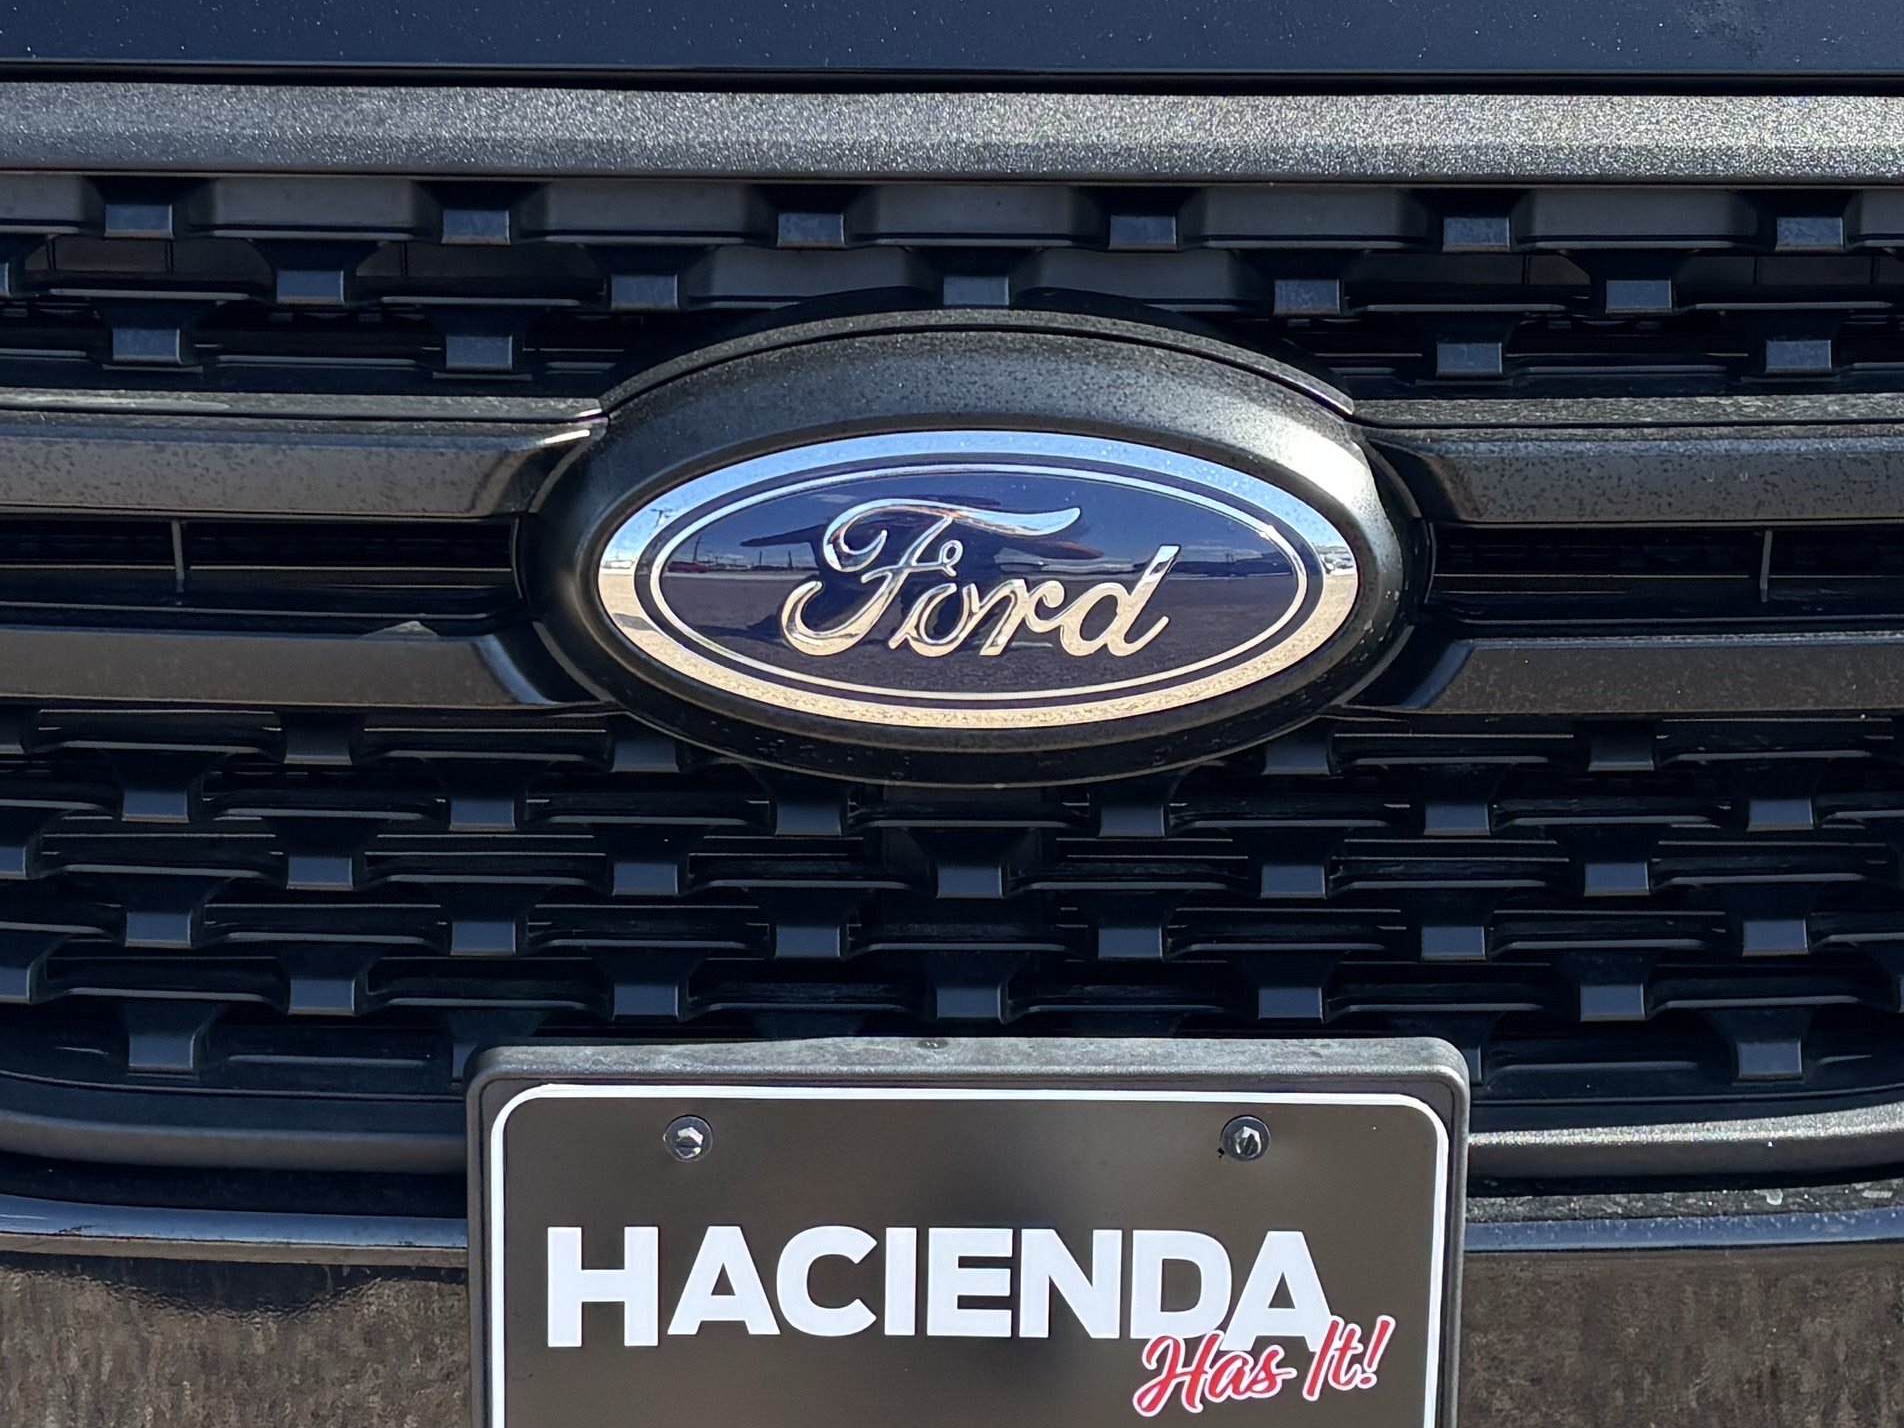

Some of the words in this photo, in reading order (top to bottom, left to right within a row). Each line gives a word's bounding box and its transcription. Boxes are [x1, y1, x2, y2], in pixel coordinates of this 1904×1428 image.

[780, 498, 1181, 659] Ford
[546, 1224, 1334, 1351] HACIENDA
[1133, 1330, 1297, 1417] Has
[1302, 1315, 1396, 1401] It!
